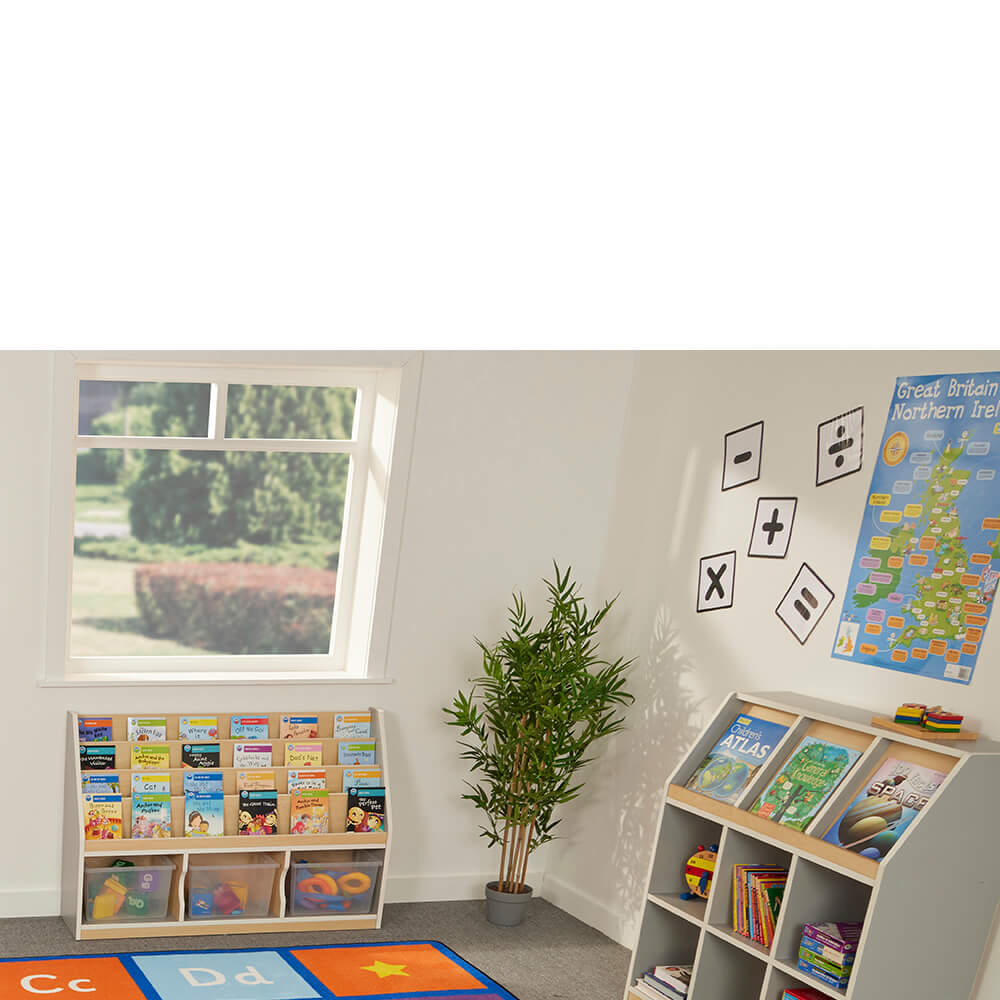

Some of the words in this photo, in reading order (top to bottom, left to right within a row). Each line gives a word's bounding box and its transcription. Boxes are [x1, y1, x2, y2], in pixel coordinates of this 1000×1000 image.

[897, 380, 940, 399] Great
[948, 378, 999, 397] Britain
[892, 402, 964, 420] Northern
[720, 734, 770, 758] ATLAS
[868, 782, 929, 811] SPACE
[21, 975, 96, 993] Cc
[179, 966, 274, 986] Dd
